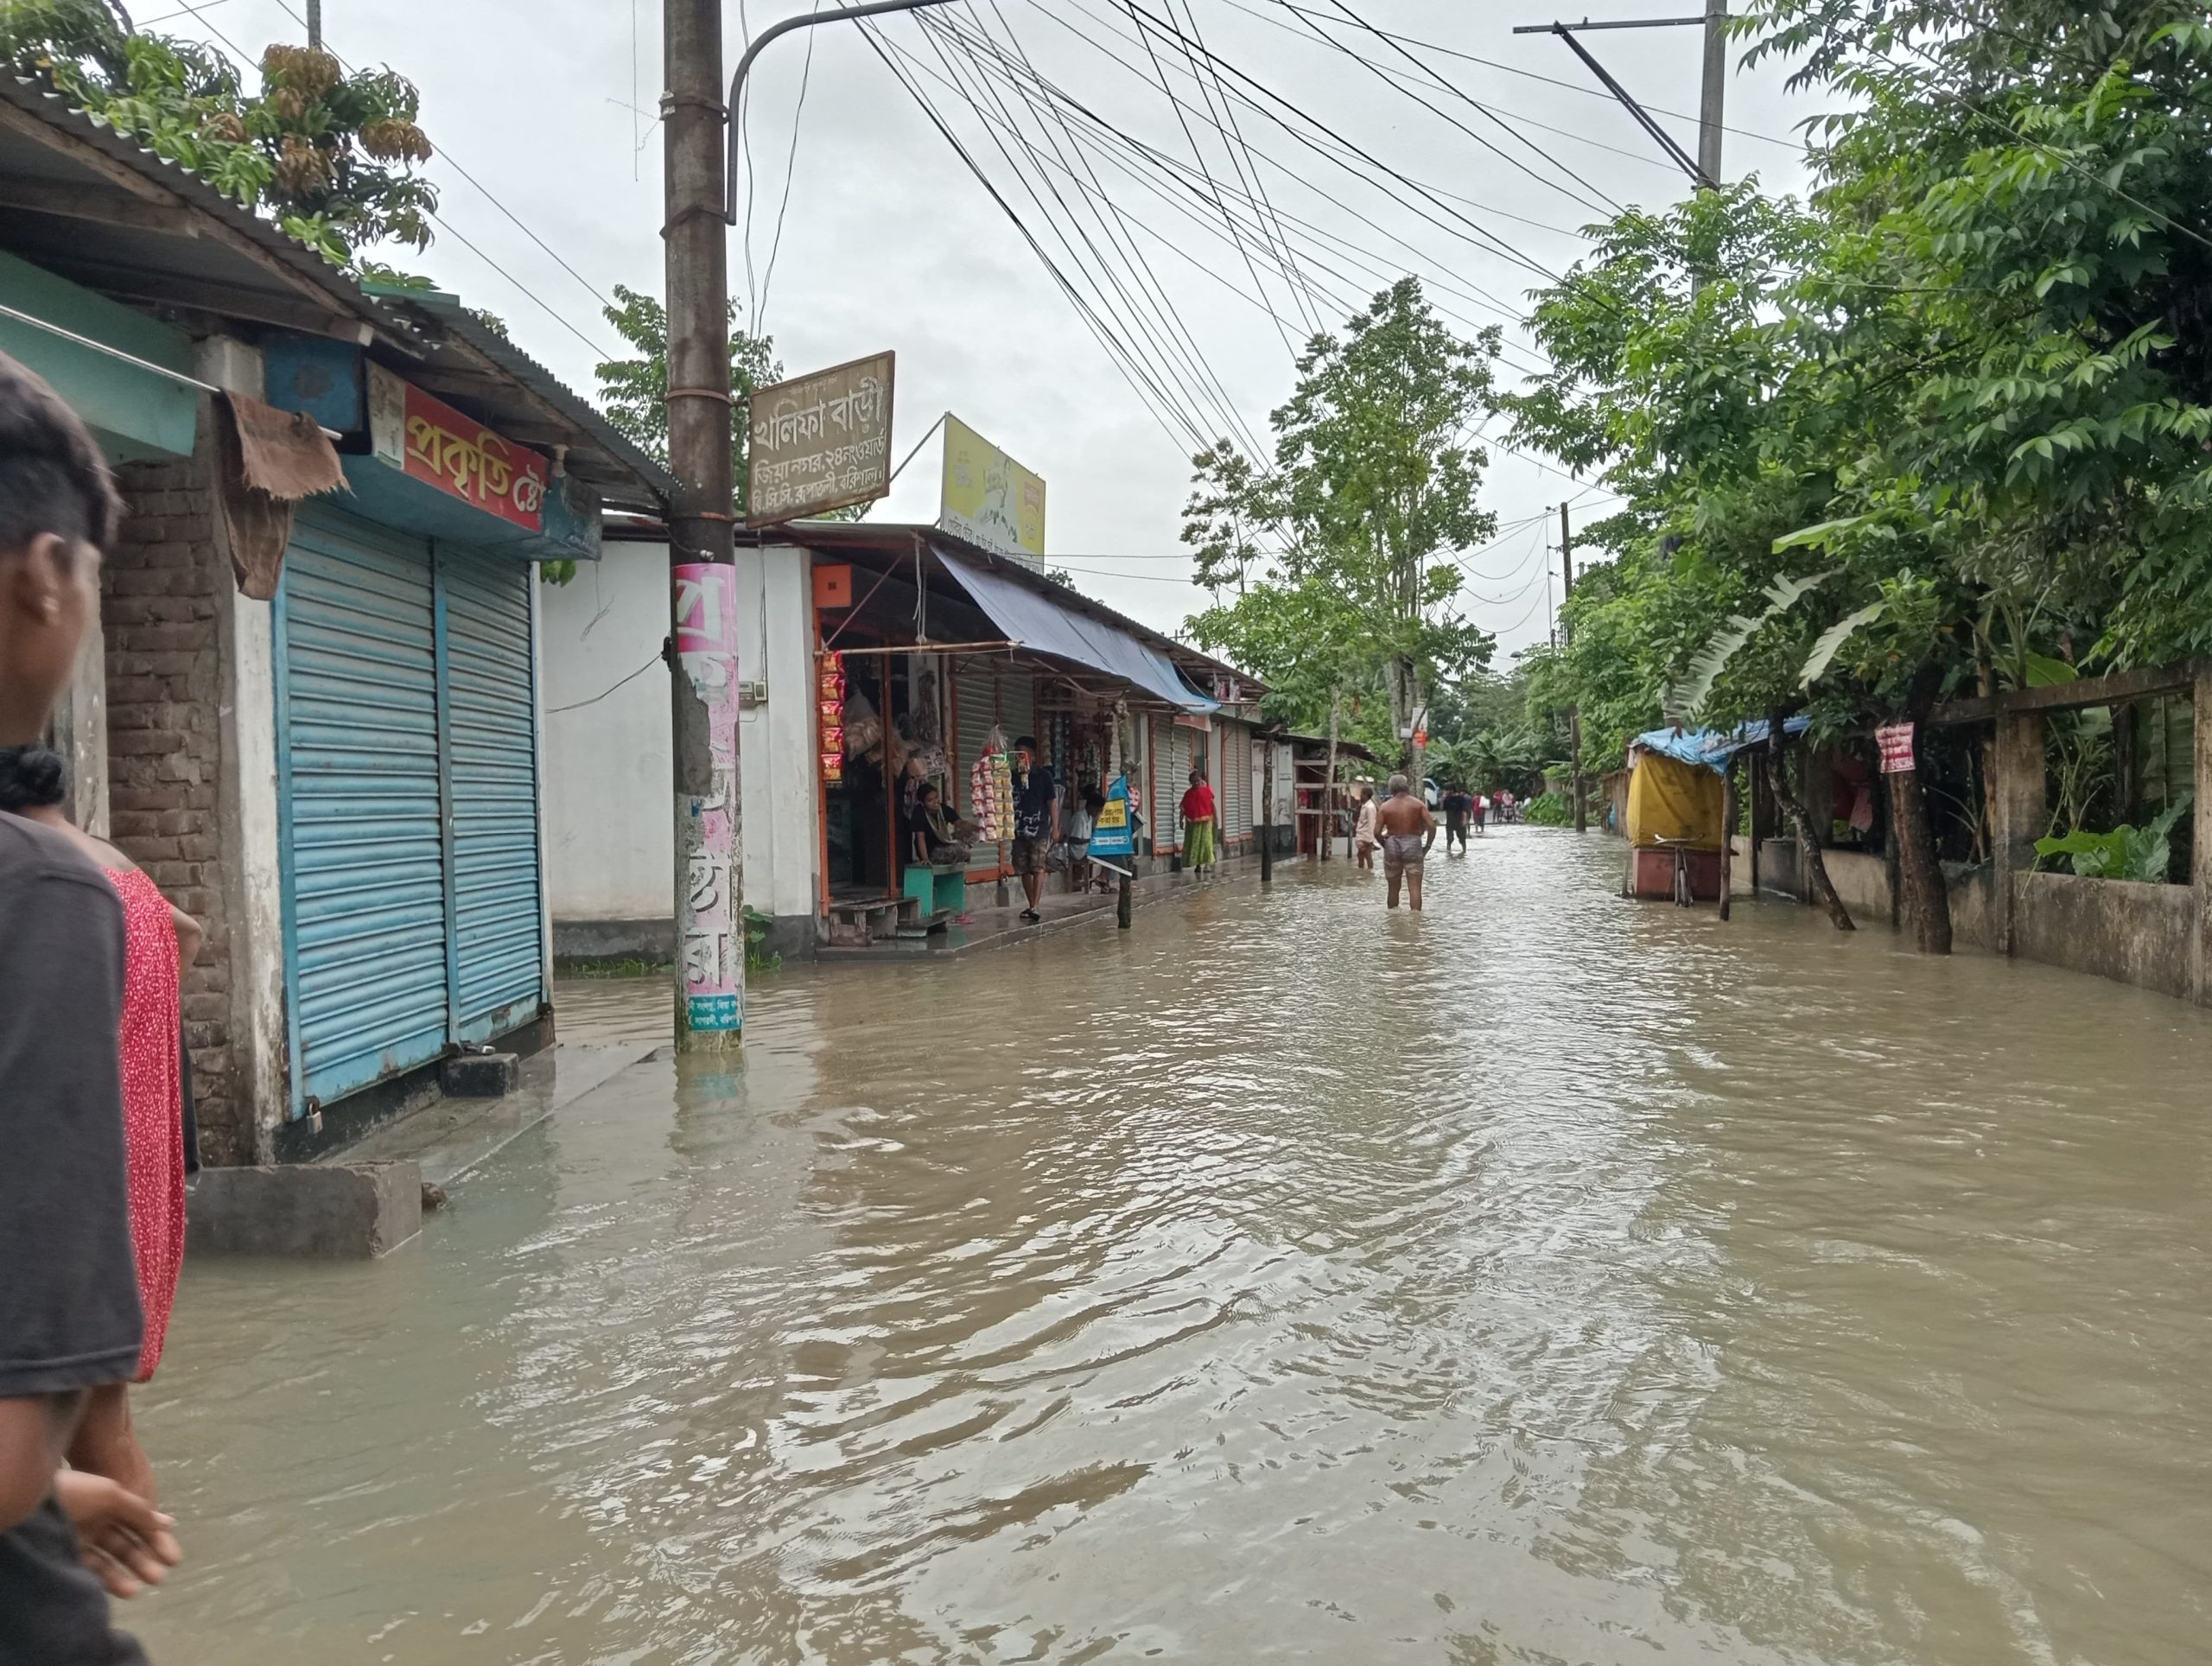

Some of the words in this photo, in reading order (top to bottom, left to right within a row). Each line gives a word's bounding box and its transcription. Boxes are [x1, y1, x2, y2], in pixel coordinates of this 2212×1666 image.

[753, 397, 827, 451] খলিফা
[828, 376, 886, 434] বাড়ী
[405, 415, 513, 502] প্রকৃতি
[753, 459, 791, 486] জিয়া
